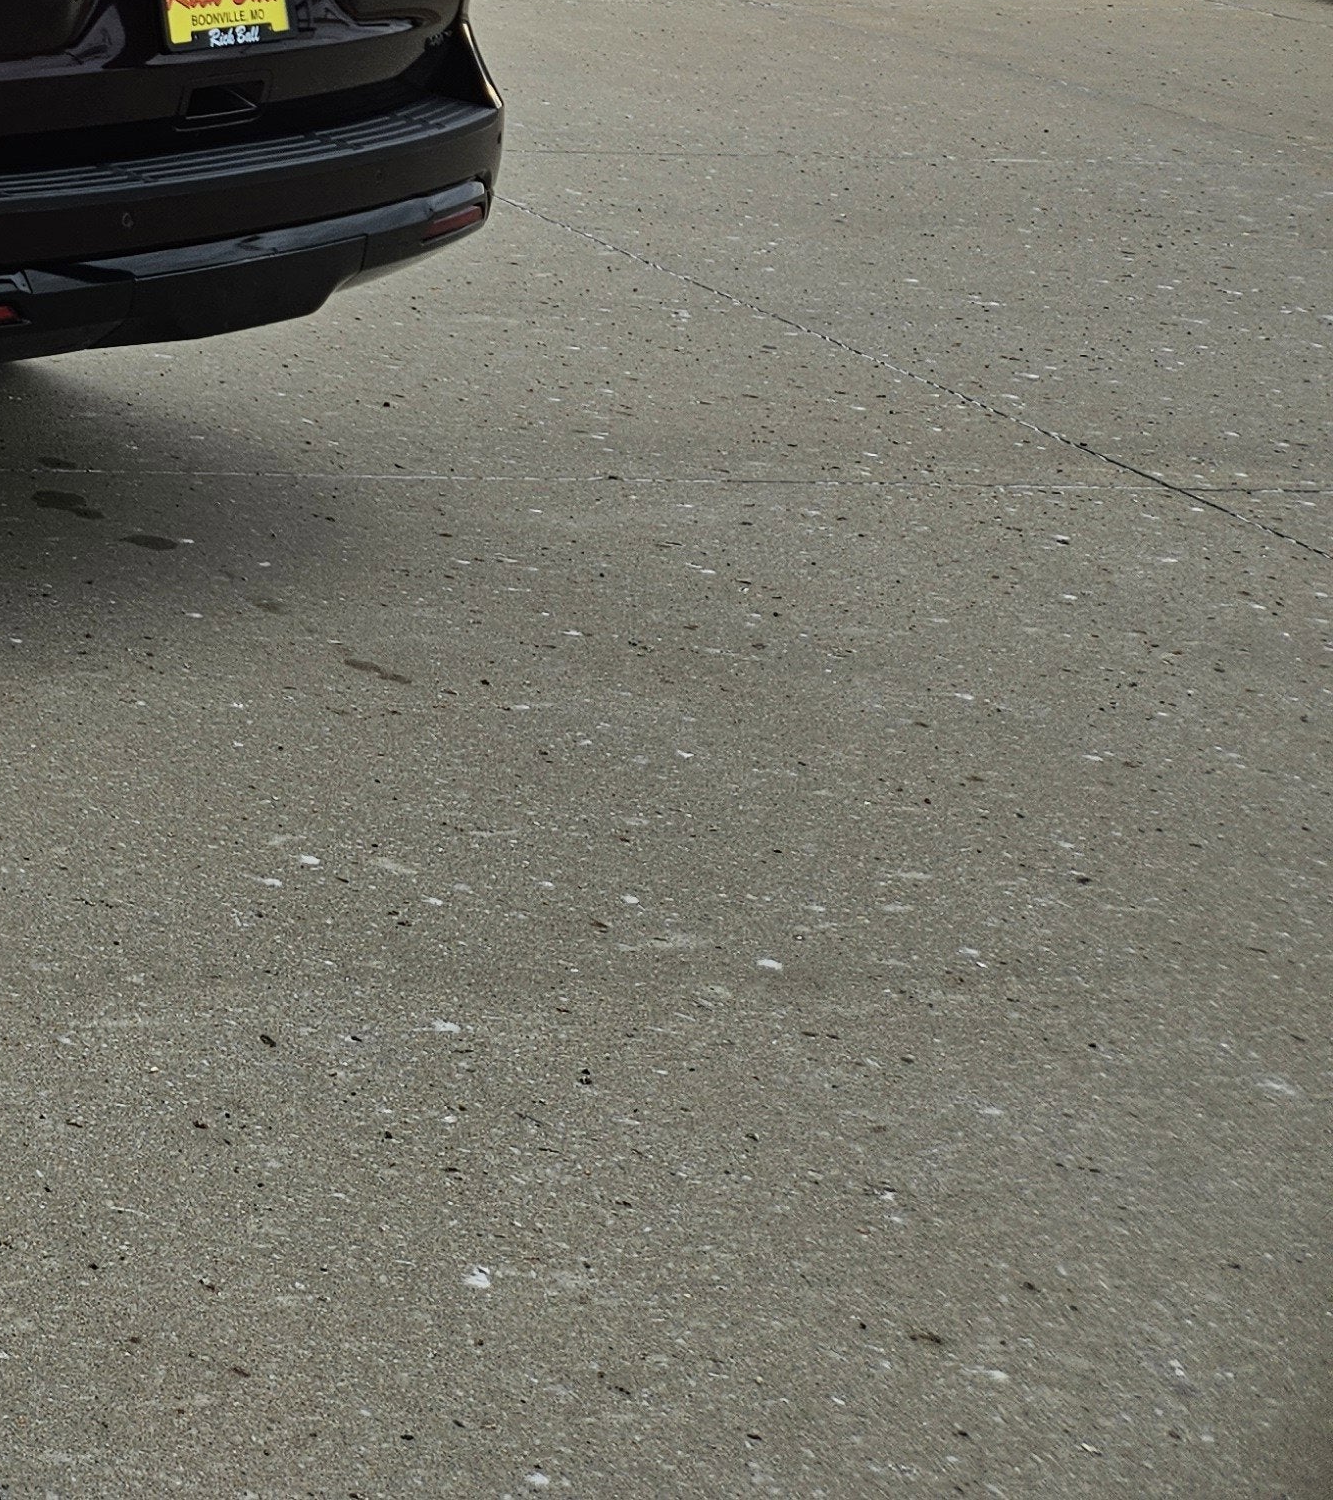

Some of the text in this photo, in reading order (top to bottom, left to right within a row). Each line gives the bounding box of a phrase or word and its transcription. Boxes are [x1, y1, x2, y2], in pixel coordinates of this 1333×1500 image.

[250, 8, 264, 20] MO
[208, 26, 260, 47] Rick Ball
